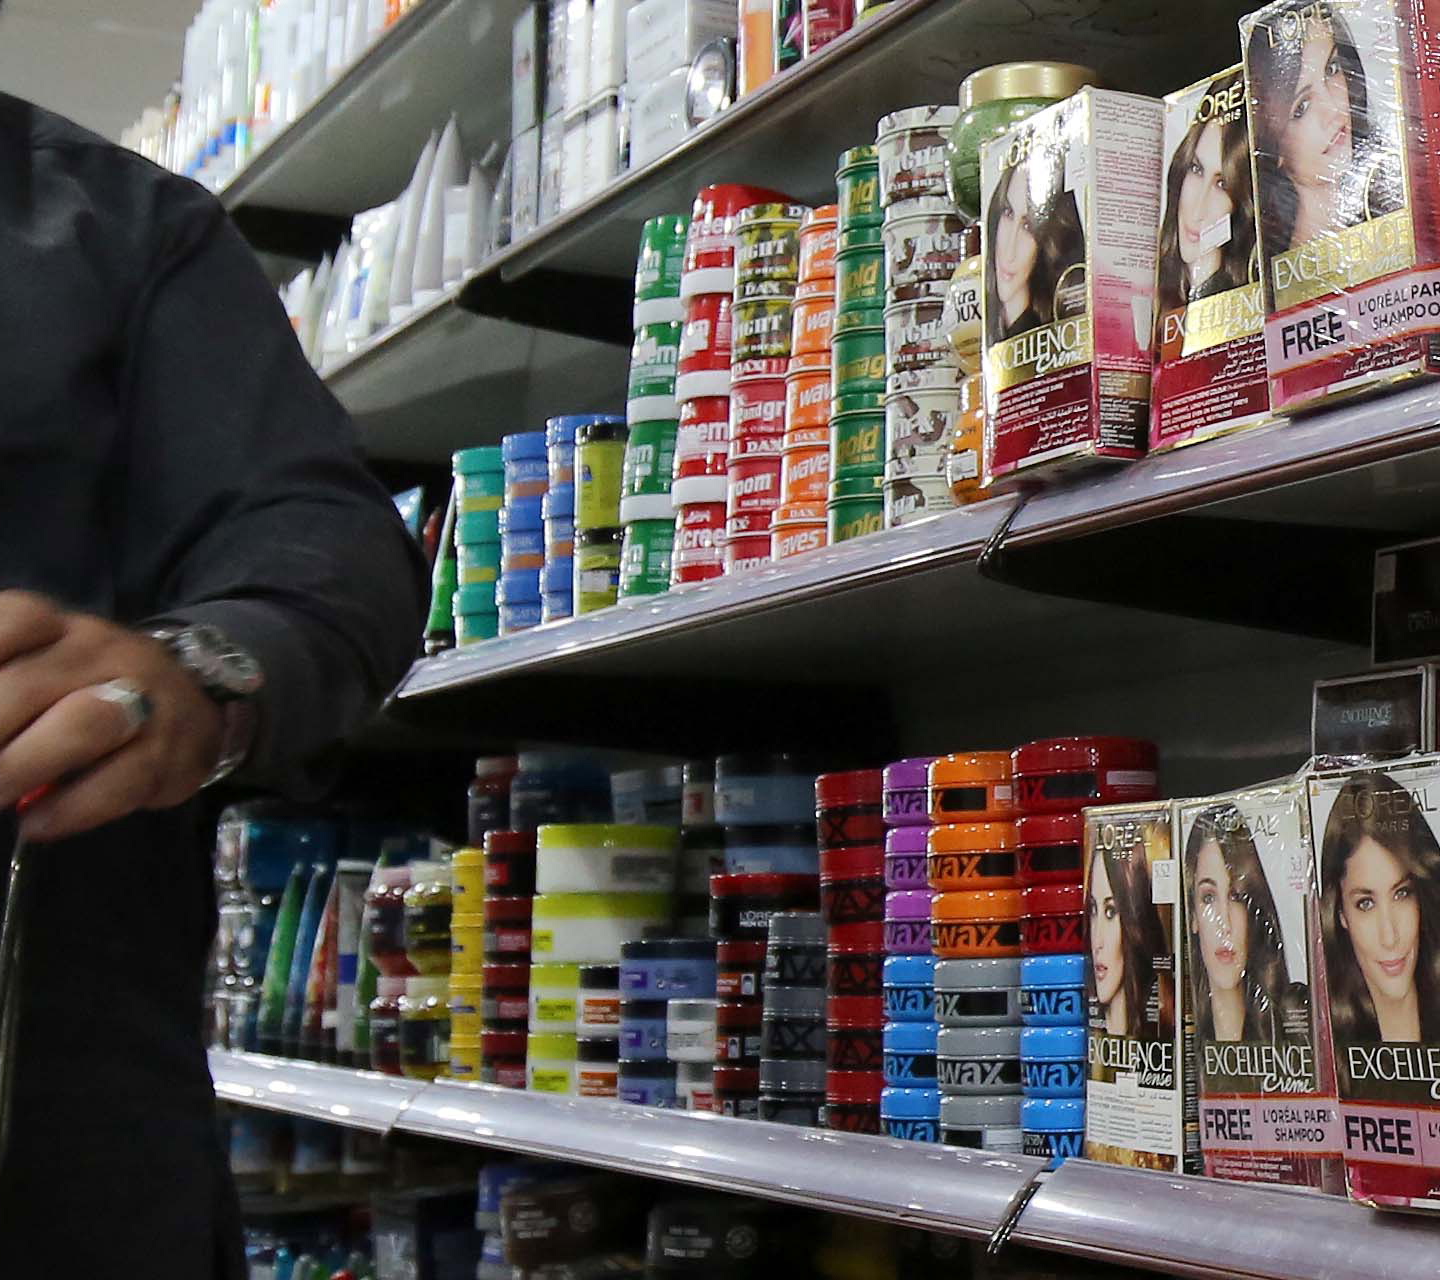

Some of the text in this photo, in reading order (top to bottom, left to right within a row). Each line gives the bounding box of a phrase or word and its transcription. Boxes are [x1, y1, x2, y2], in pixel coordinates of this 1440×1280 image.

[744, 281, 781, 296] DAX
[1359, 288, 1409, 317] L'ORÉAL
[1280, 311, 1346, 360] FREE
[935, 925, 1001, 947] wax
[1087, 1036, 1173, 1072] EXCELLENCE
[1204, 1044, 1314, 1076] EXCELLENCE
[944, 1062, 1003, 1086] wax
[1204, 1108, 1253, 1141] FREE
[1261, 1106, 1302, 1125] L'ORÉAL
[1273, 1127, 1325, 1144] SHAMPOO
[1345, 1114, 1415, 1157] FREE
